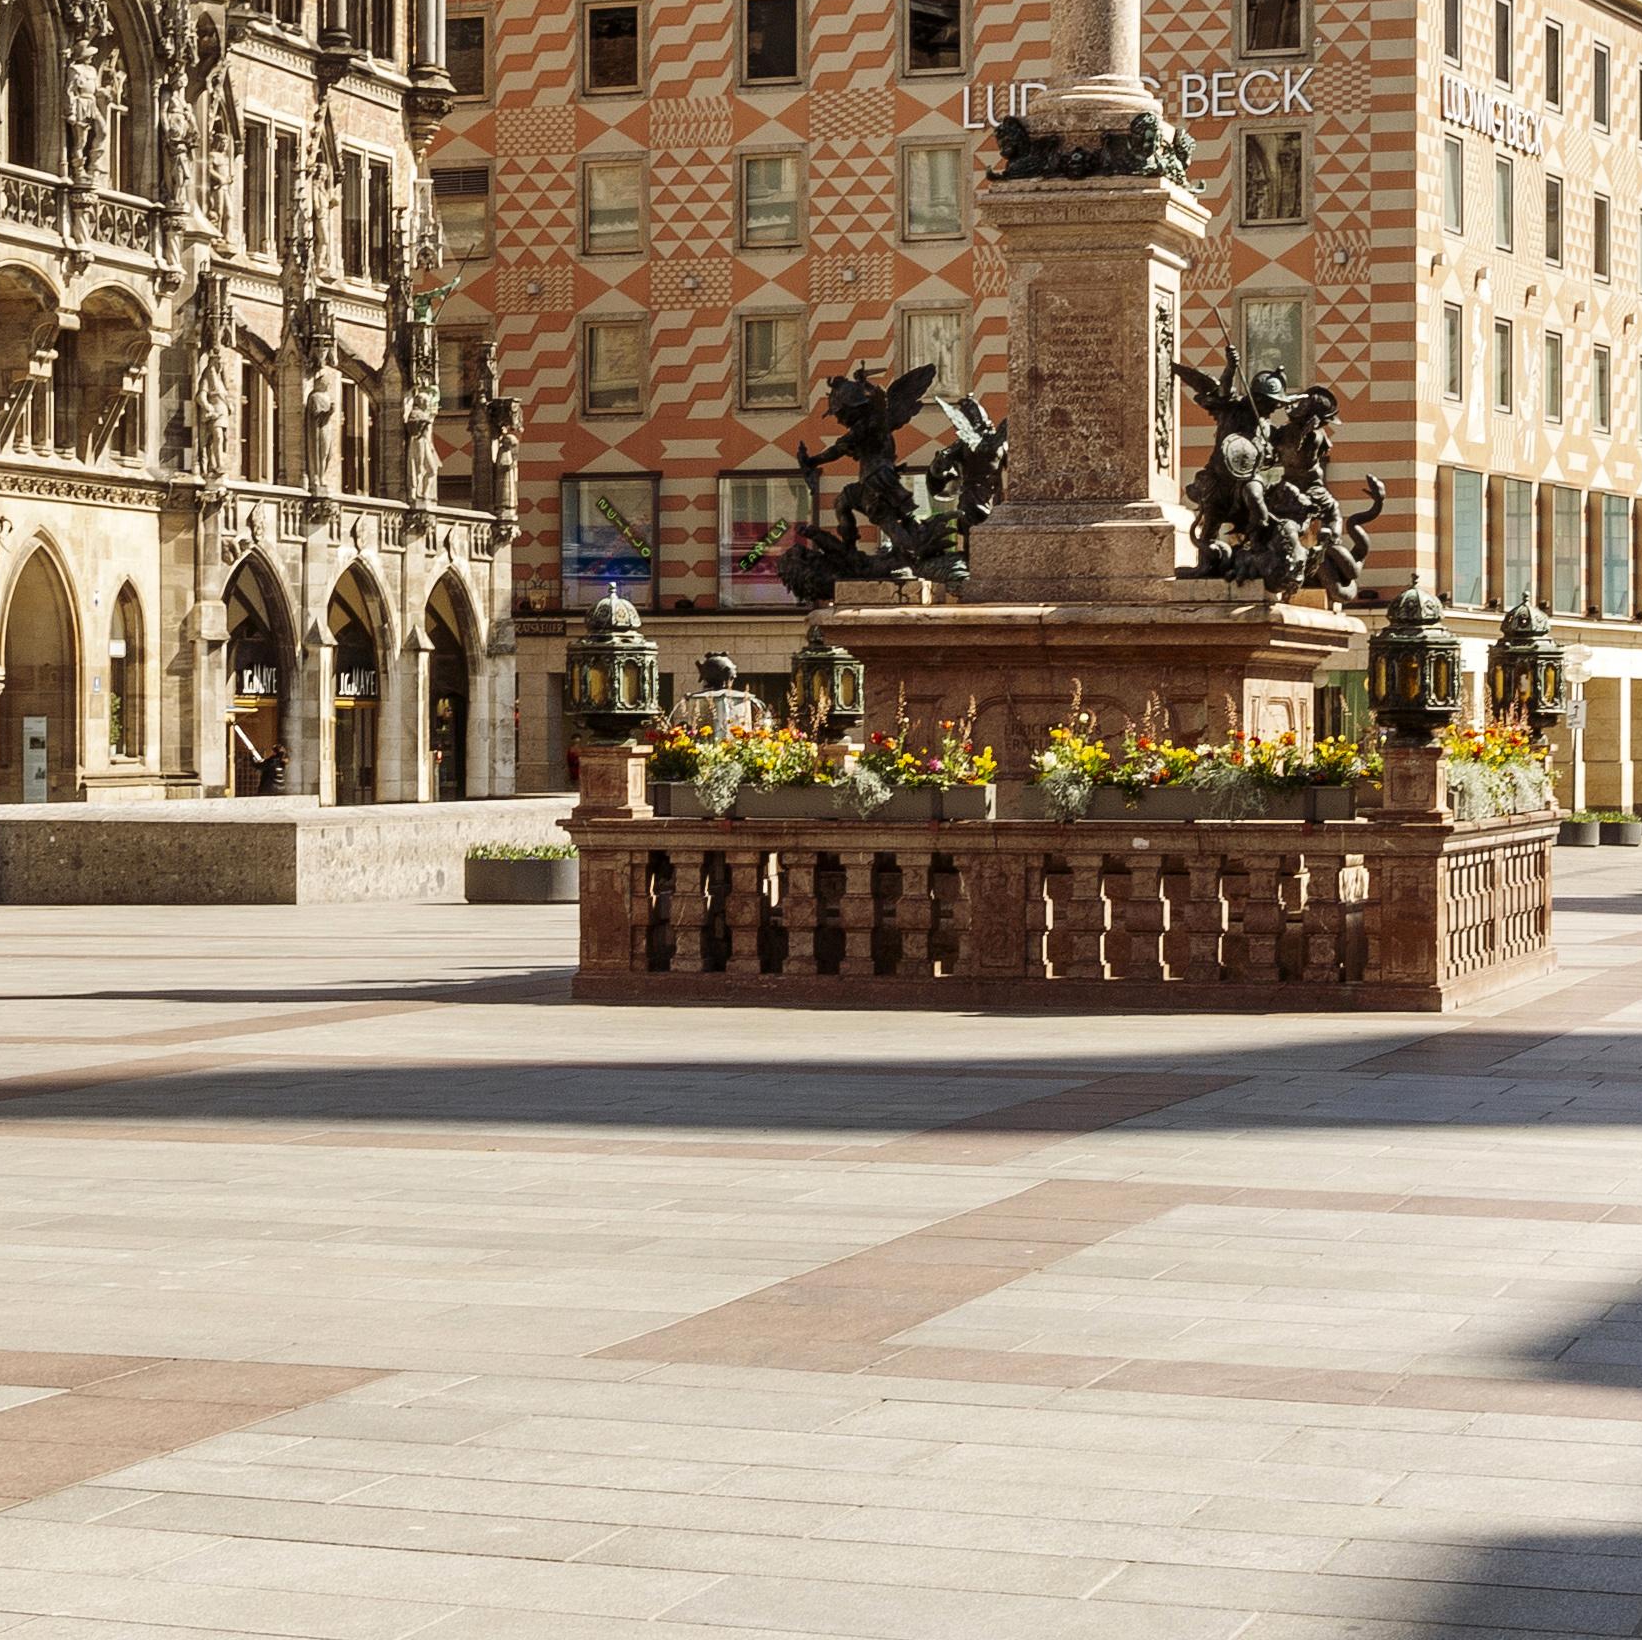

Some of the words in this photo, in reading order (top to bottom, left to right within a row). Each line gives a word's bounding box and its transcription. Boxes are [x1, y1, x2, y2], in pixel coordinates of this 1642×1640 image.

[1182, 67, 1314, 119] BECK
[1441, 72, 1505, 142] LUDWIG
[1506, 102, 1546, 159] BECK
